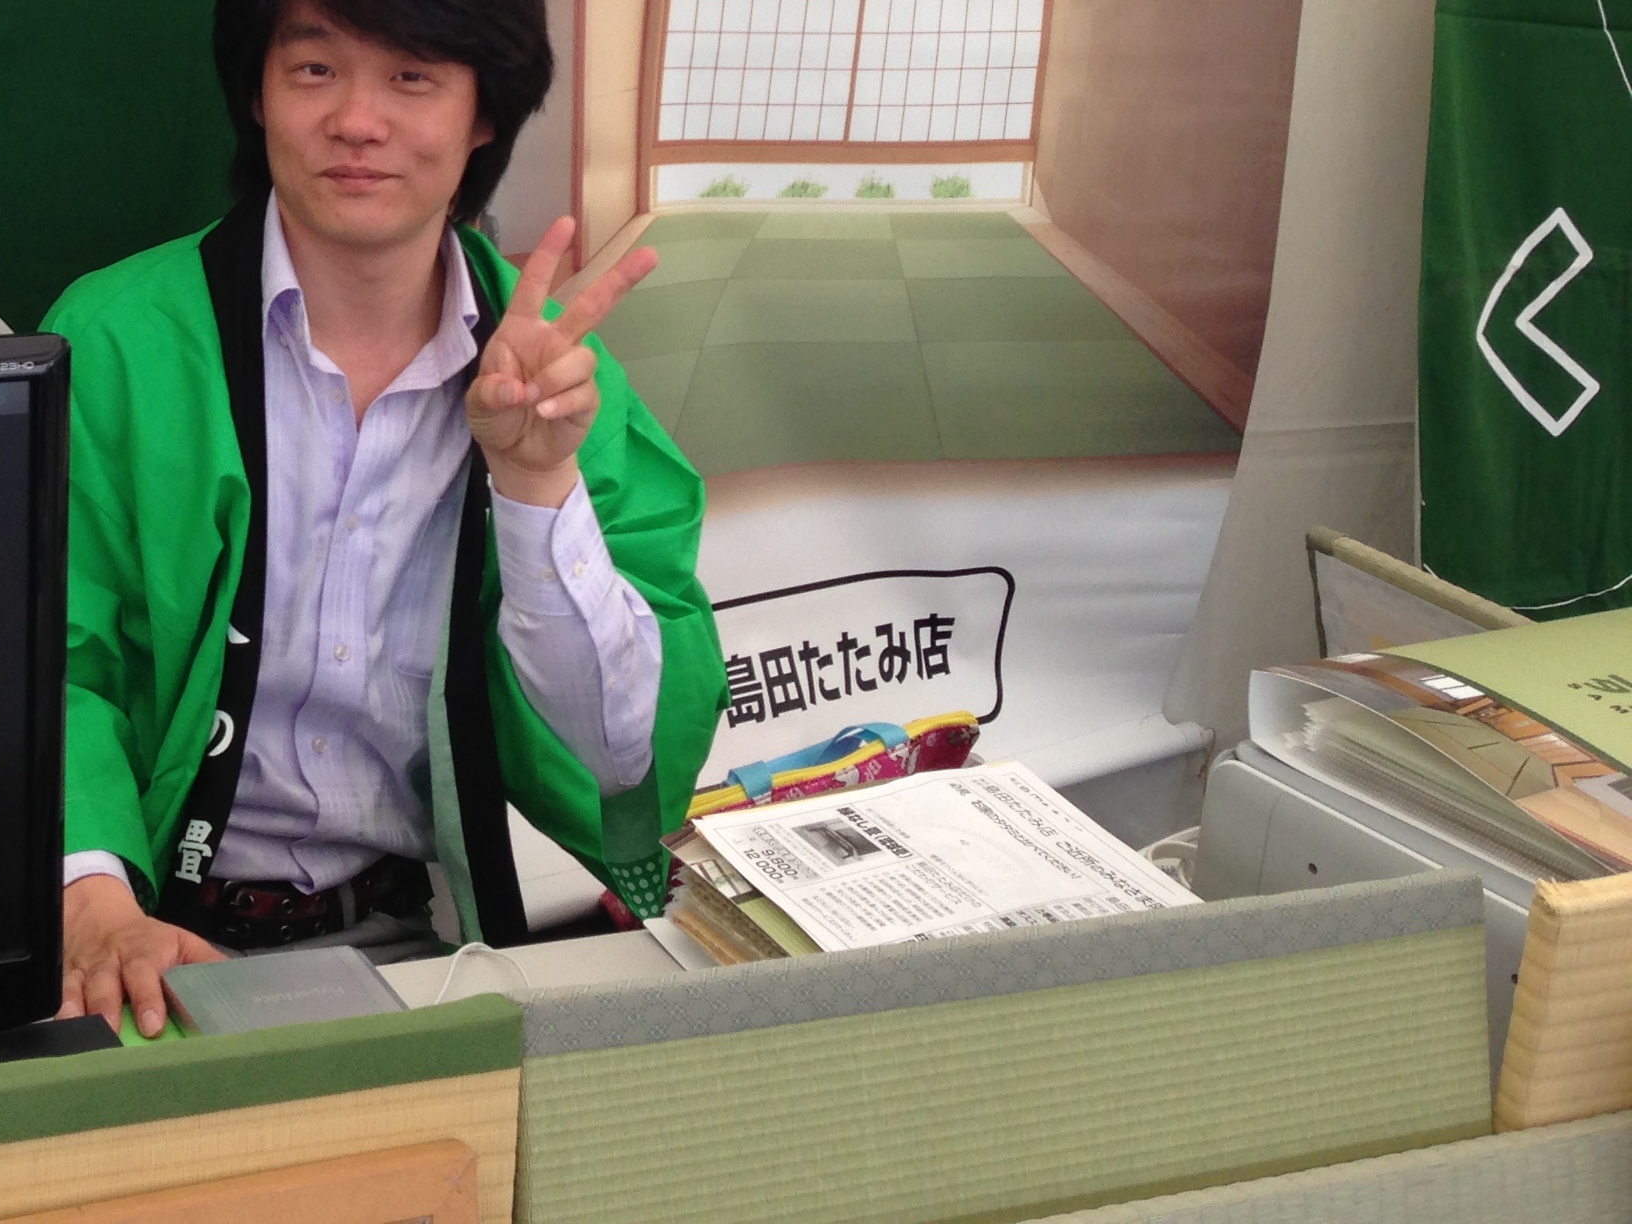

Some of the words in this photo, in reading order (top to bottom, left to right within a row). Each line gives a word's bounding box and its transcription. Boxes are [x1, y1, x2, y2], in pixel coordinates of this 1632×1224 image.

[725, 613, 956, 728] 島田たたみ店
